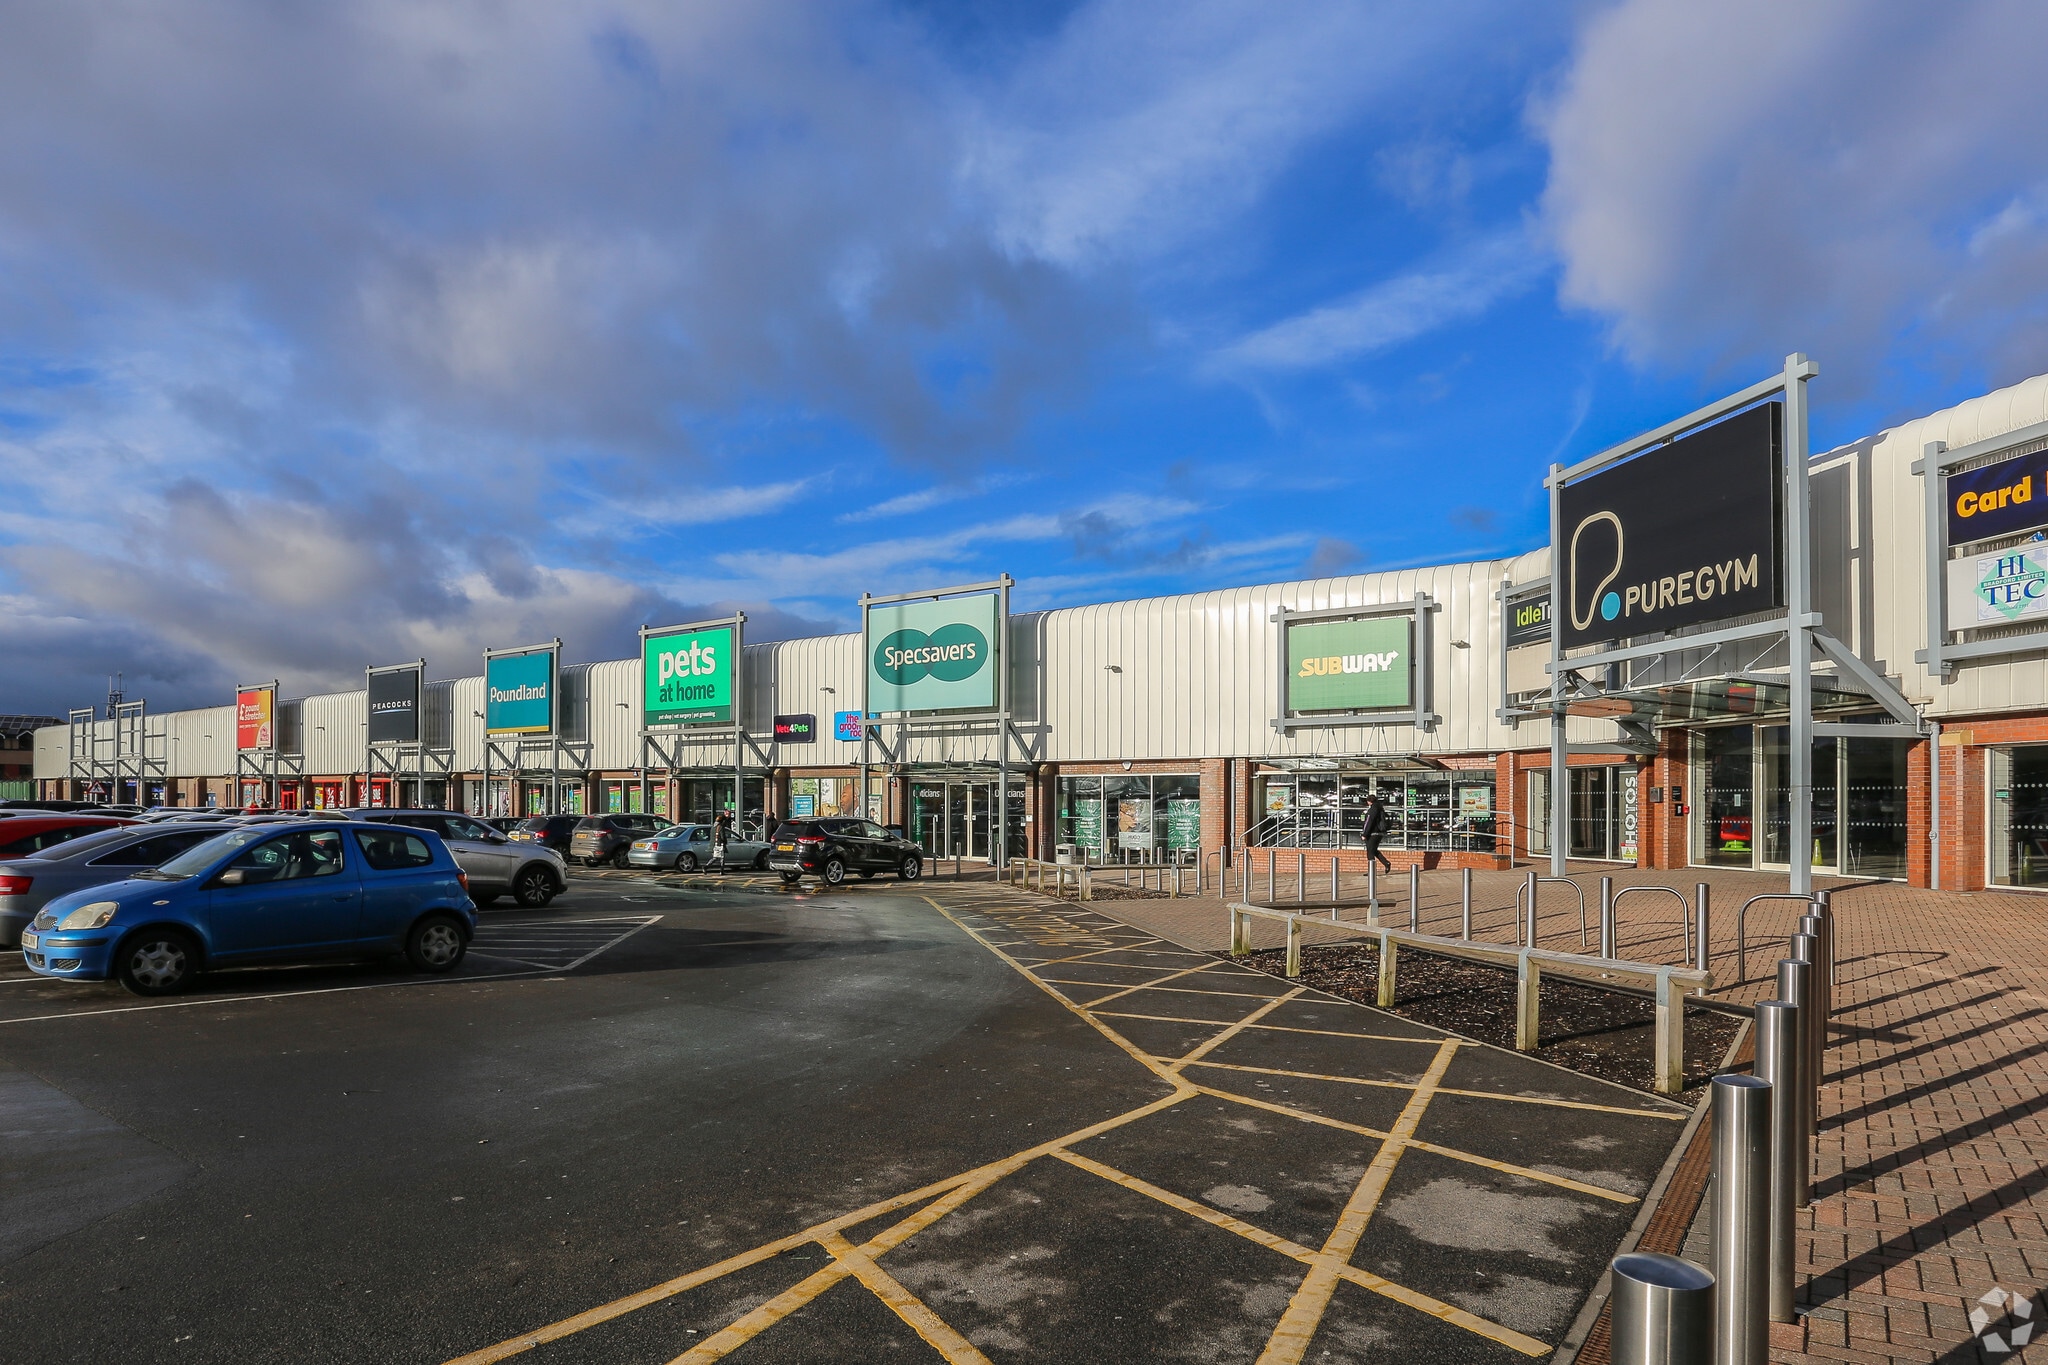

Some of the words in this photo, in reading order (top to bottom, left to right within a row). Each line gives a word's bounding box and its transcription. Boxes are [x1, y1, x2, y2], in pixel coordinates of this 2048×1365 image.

[1956, 475, 2032, 518] Card
[1996, 554, 2026, 578] HI
[1625, 553, 1758, 618] PUREGYM
[1983, 577, 2016, 587] BRADFORD
[2017, 572, 2044, 581] LIMITED
[1983, 578, 2046, 606] TEC
[1516, 601, 1551, 627] IdleTr
[658, 640, 716, 687] pets
[884, 642, 976, 671] Specsavers
[1297, 650, 1399, 678] SUBWAY
[490, 682, 546, 703] Poundland
[659, 683, 674, 703] at
[676, 680, 715, 702] home
[372, 700, 412, 710] PEACOCKS
[775, 723, 809, 734] Vets4Pets
[846, 713, 859, 723] the
